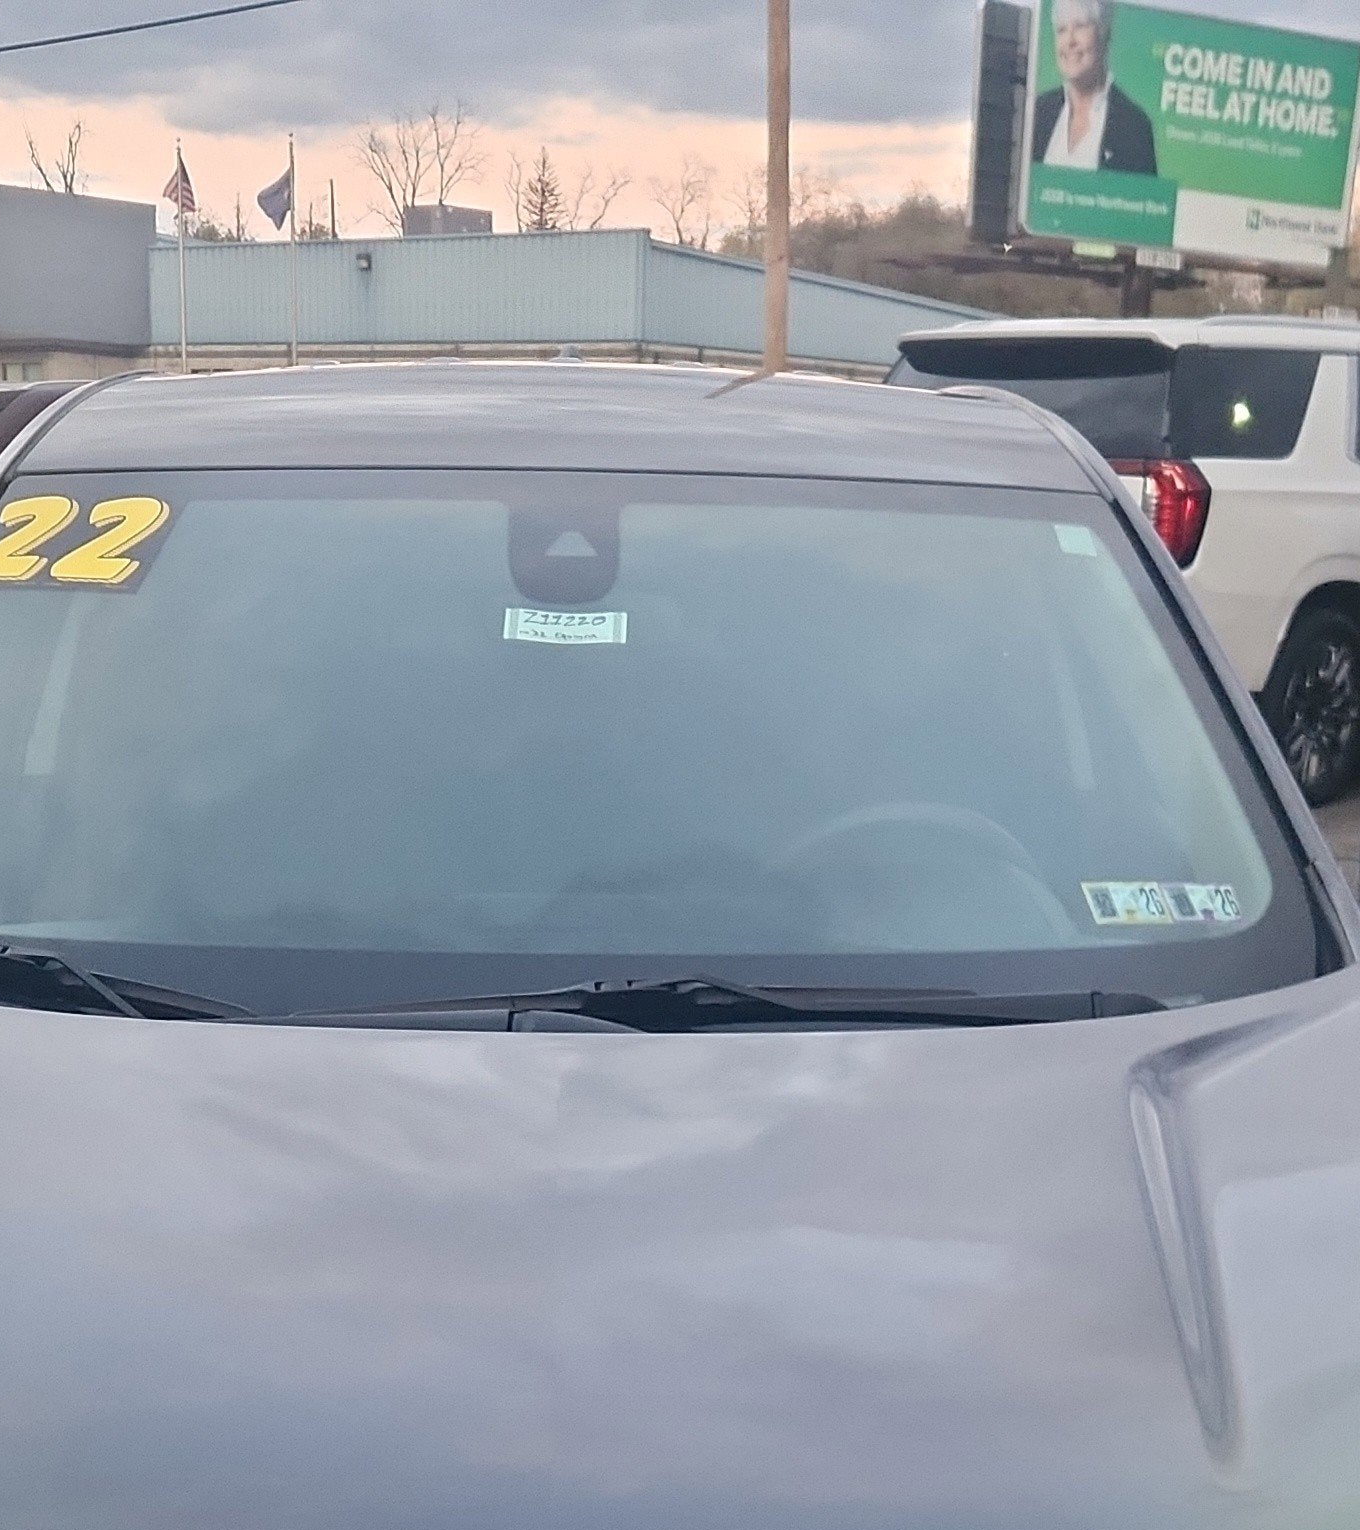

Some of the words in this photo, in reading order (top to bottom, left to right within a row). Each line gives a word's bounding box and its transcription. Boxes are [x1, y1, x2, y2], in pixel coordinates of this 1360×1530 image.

[1164, 43, 1244, 86] COME
[1246, 57, 1276, 92] IN
[1275, 63, 1332, 100] AND
[1160, 79, 1220, 120] FEEL
[1222, 91, 1257, 126] AT
[1138, 887, 1165, 916] 26
[1214, 888, 1241, 917] 26
